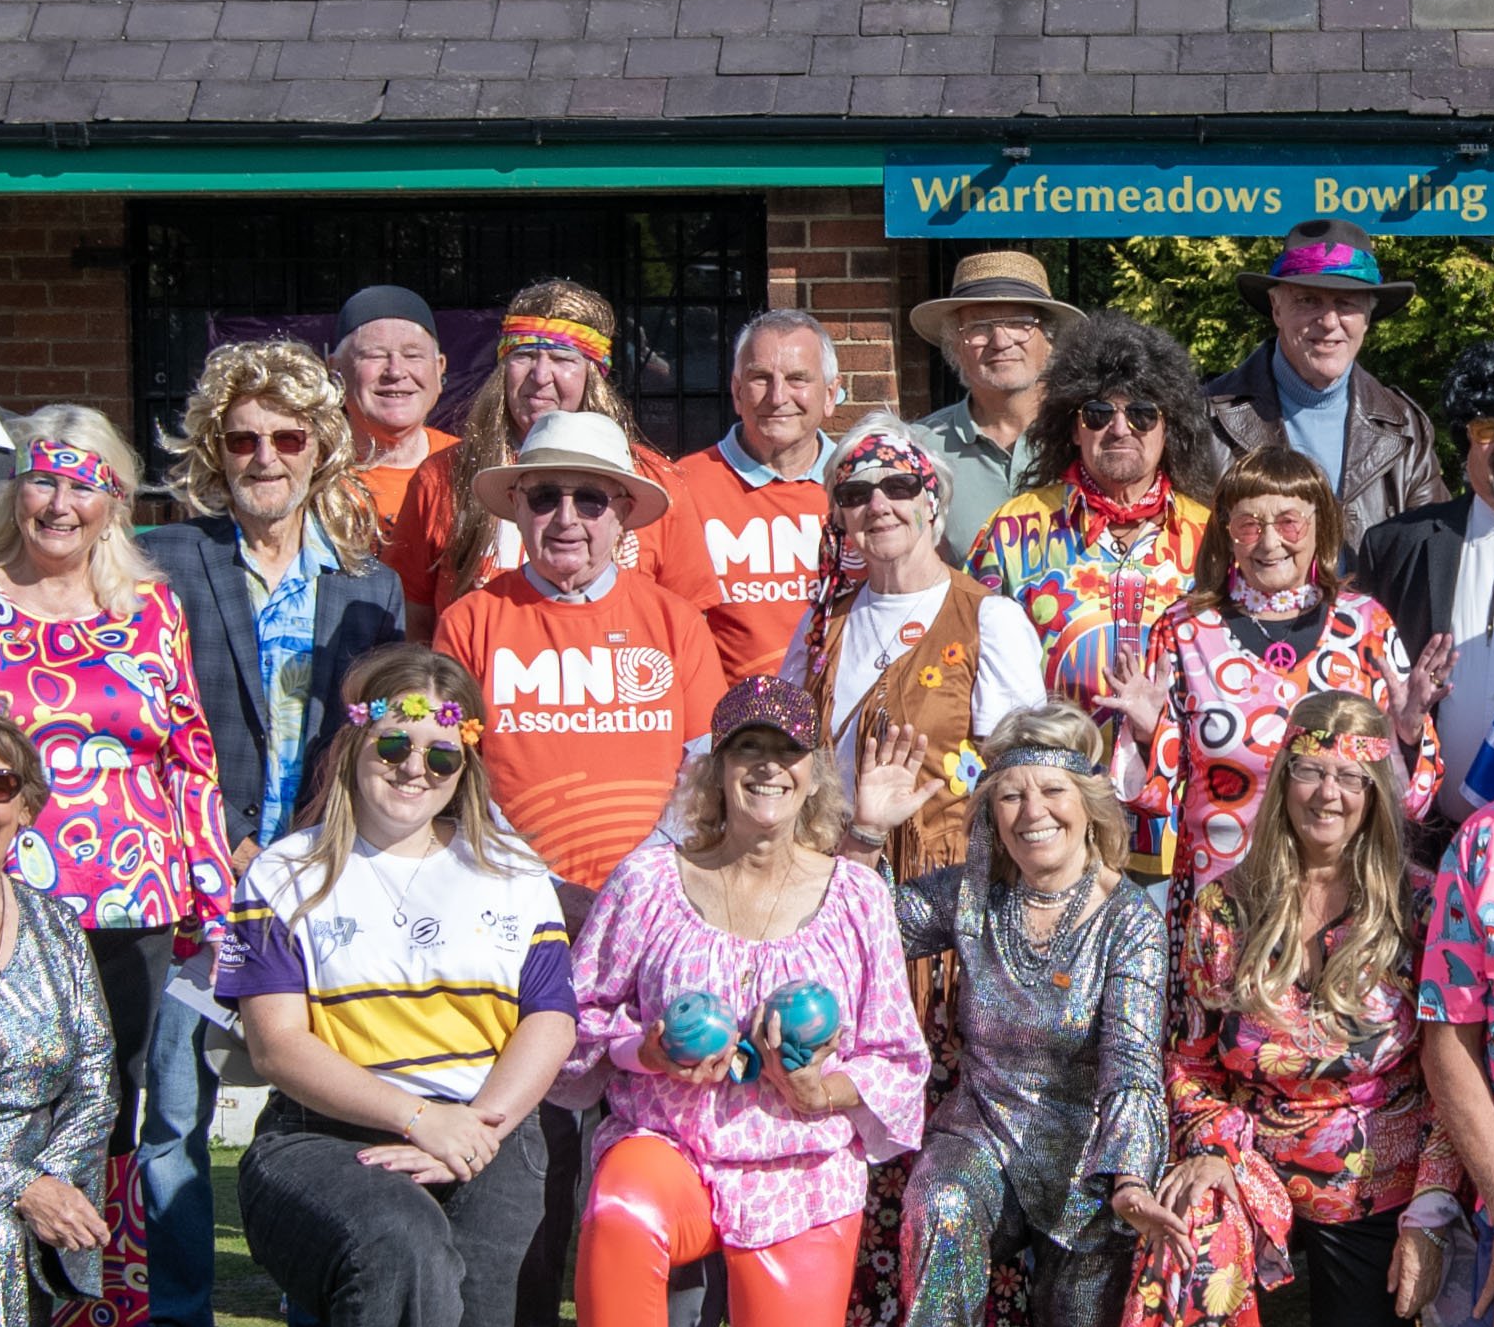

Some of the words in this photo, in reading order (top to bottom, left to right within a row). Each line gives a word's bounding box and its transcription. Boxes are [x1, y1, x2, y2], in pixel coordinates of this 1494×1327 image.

[911, 174, 1282, 215] Wharfemeadows
[1314, 174, 1488, 223] Bowling
[493, 646, 674, 705] MND
[495, 705, 672, 733] Association
